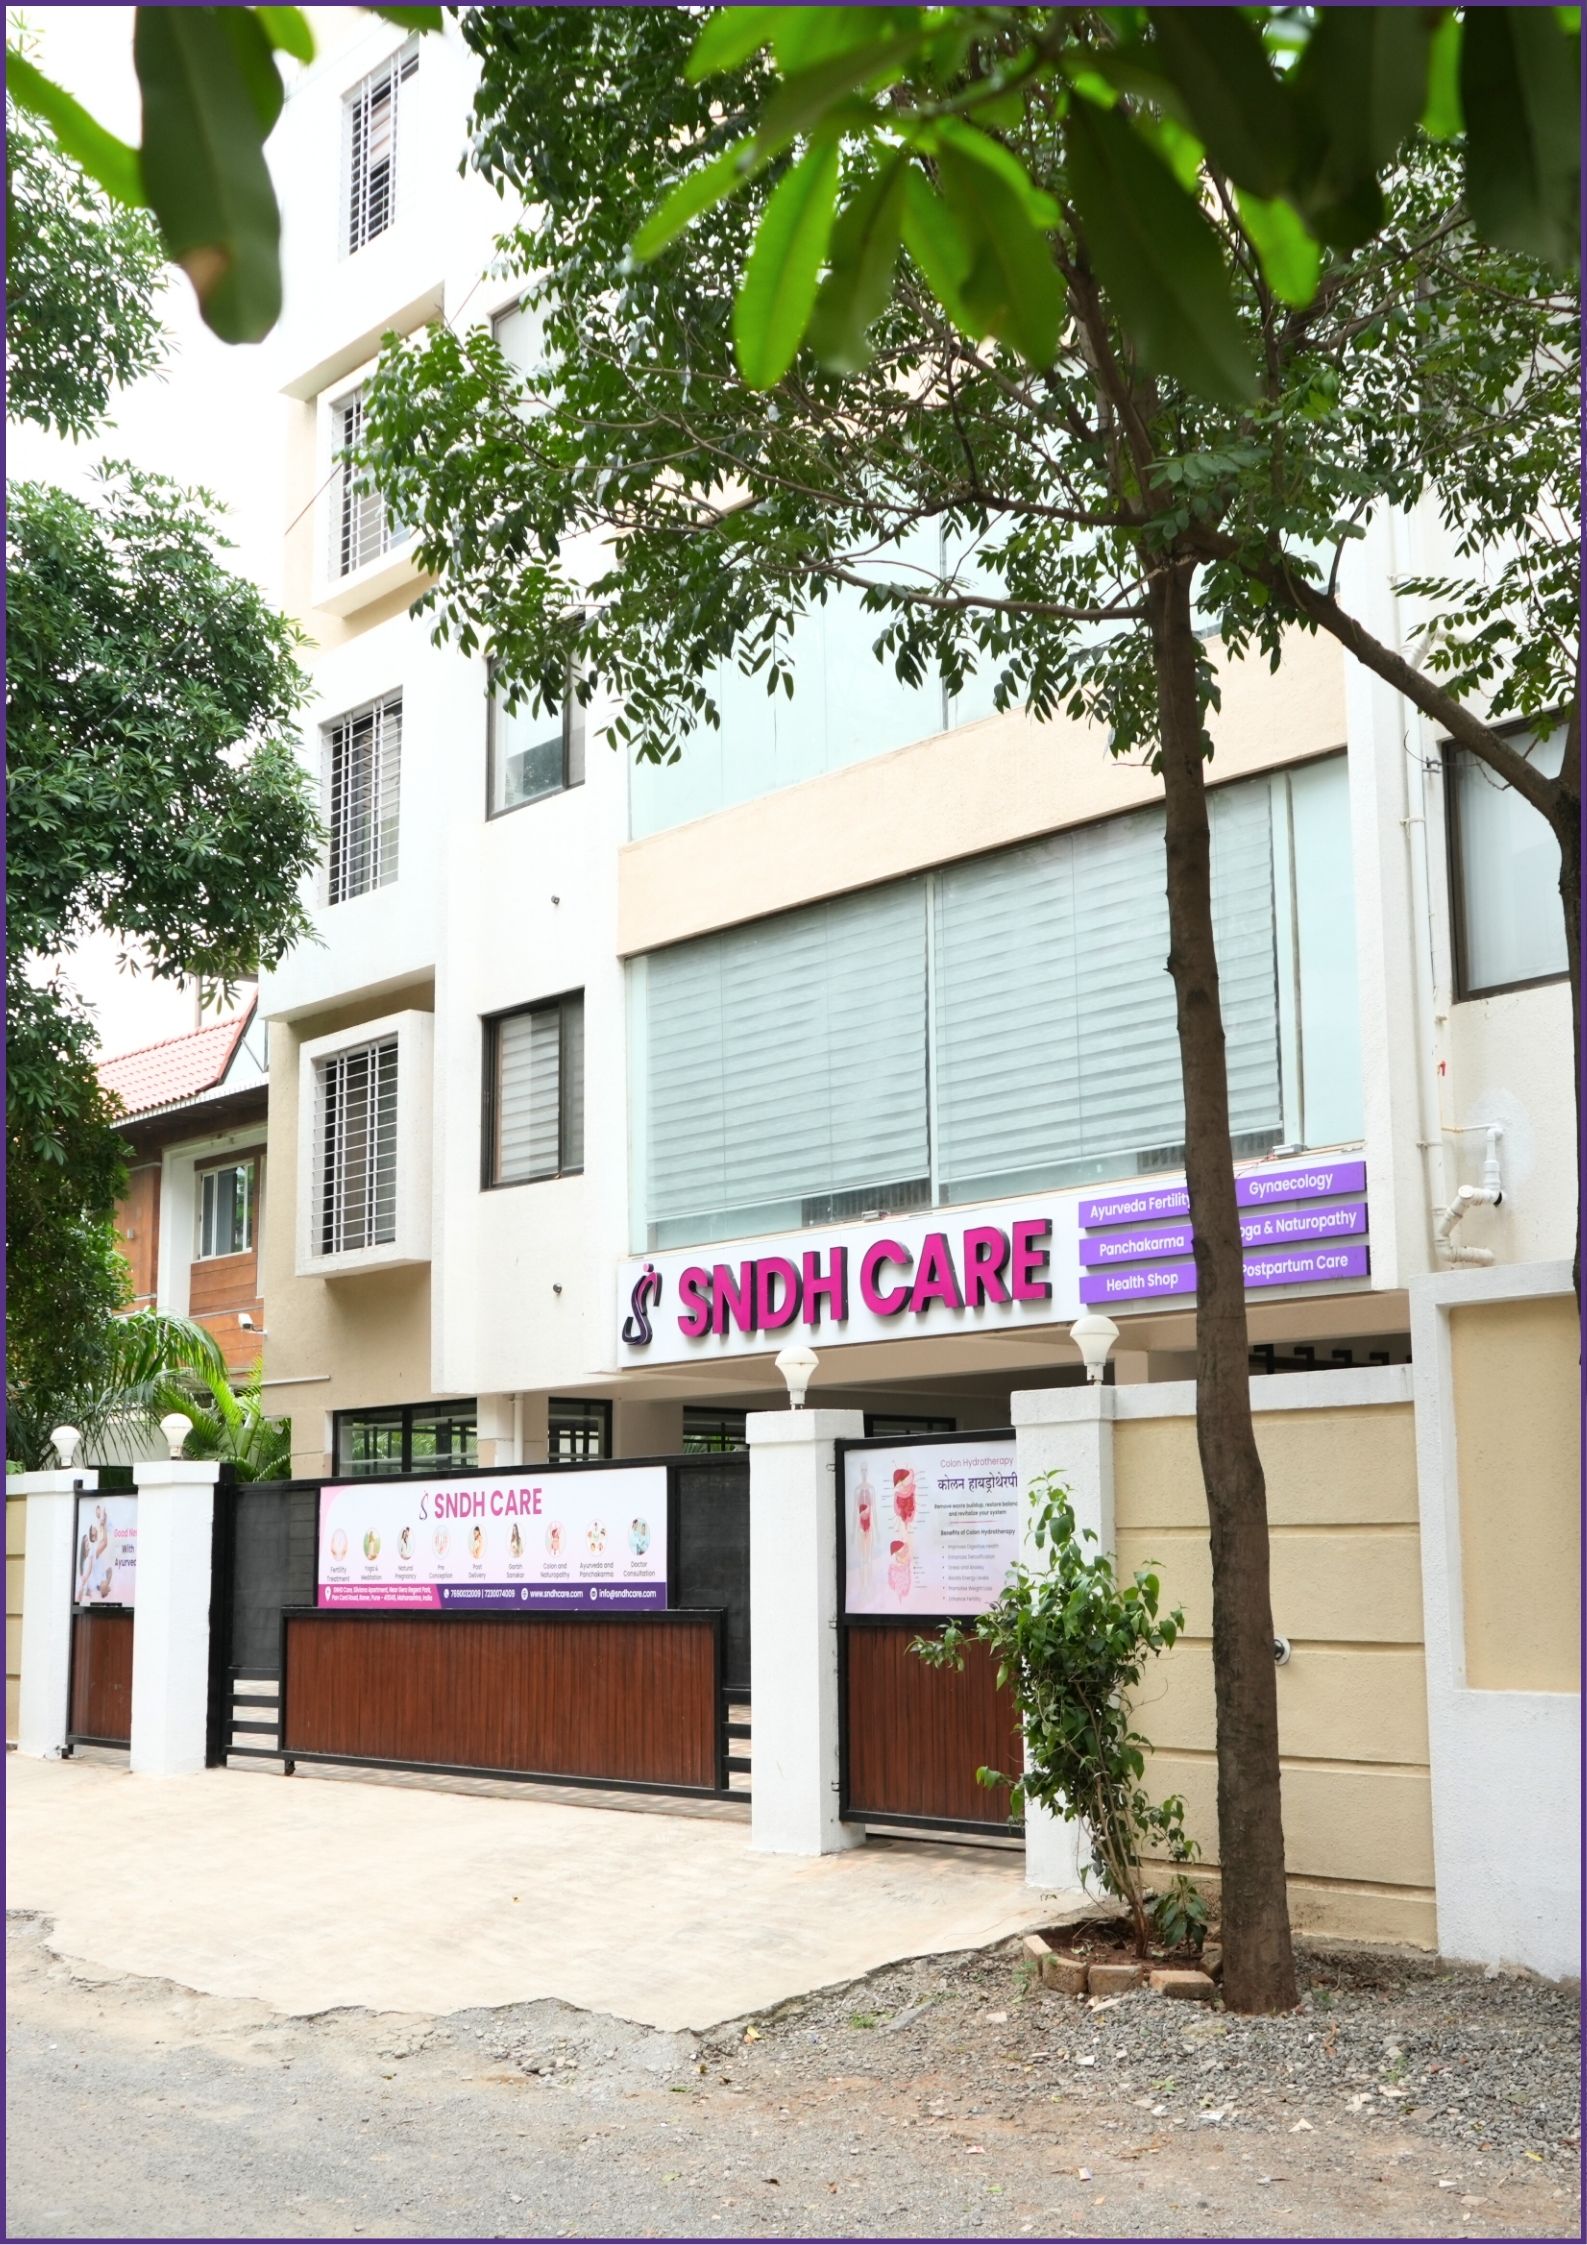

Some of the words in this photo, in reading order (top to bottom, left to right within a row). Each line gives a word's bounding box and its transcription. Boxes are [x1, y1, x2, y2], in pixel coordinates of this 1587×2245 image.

[1249, 1173, 1333, 1198] Gynaecology
[1090, 1199, 1146, 1221] Ayurveda
[1149, 1191, 1191, 1210] Fertility
[1240, 1226, 1261, 1241] oga
[1264, 1220, 1273, 1234] &
[1276, 1210, 1357, 1232] Naturopathy
[1100, 1236, 1185, 1256] Panchakarma
[1317, 1255, 1349, 1269] Care
[678, 1246, 848, 1338] SNDH
[860, 1217, 1053, 1316] CARE
[1106, 1275, 1145, 1291] Health
[1147, 1273, 1178, 1289] Shop
[940, 1459, 961, 1468] Colon
[963, 1457, 1014, 1469] Hydrotherapy
[937, 1474, 965, 1490] कोलन
[434, 1491, 485, 1519] SNDH
[490, 1488, 542, 1516] CARE
[981, 1528, 1015, 1536] Hydrotherapy
[122, 1544, 134, 1553] With
[580, 1562, 603, 1570] Ayurveda
[530, 1589, 583, 1598] www.sndhcare.com
[599, 1588, 656, 1600] info@sndhcare.com
